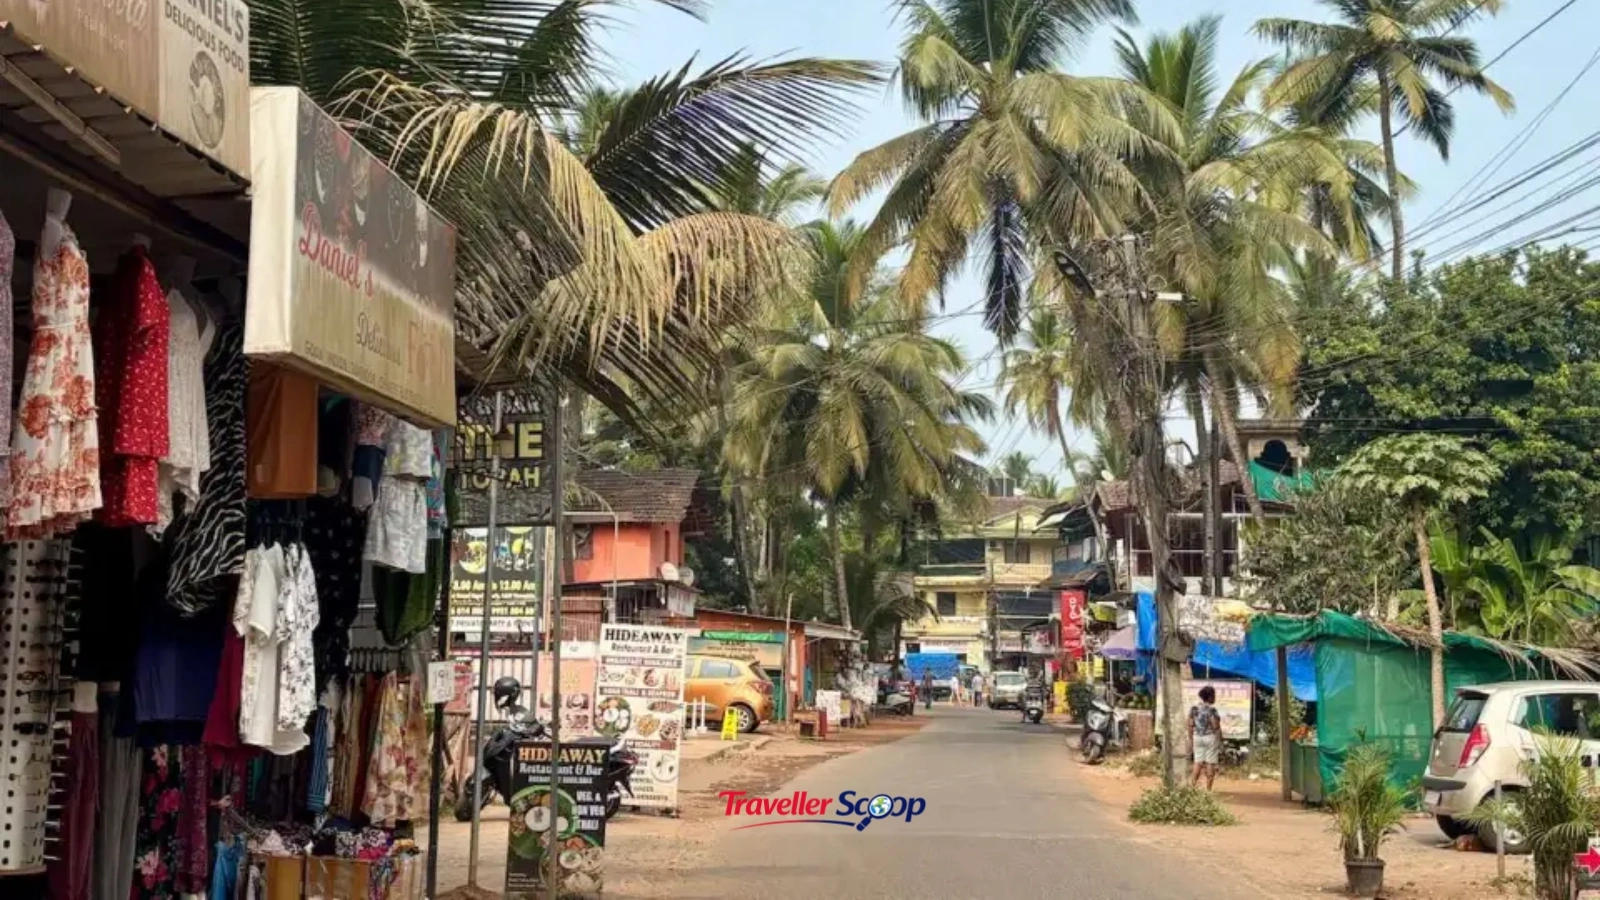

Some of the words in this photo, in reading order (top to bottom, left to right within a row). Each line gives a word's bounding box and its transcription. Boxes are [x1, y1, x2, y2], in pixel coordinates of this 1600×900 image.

[165, 2, 216, 52] DELICIOUS
[218, 39, 244, 73] FOOD
[299, 202, 374, 298] Daniel's
[604, 628, 682, 644] HIDEAWAY
[611, 643, 652, 654] Restaurant
[519, 762, 574, 776] Restauant
[585, 764, 604, 776] Bar
